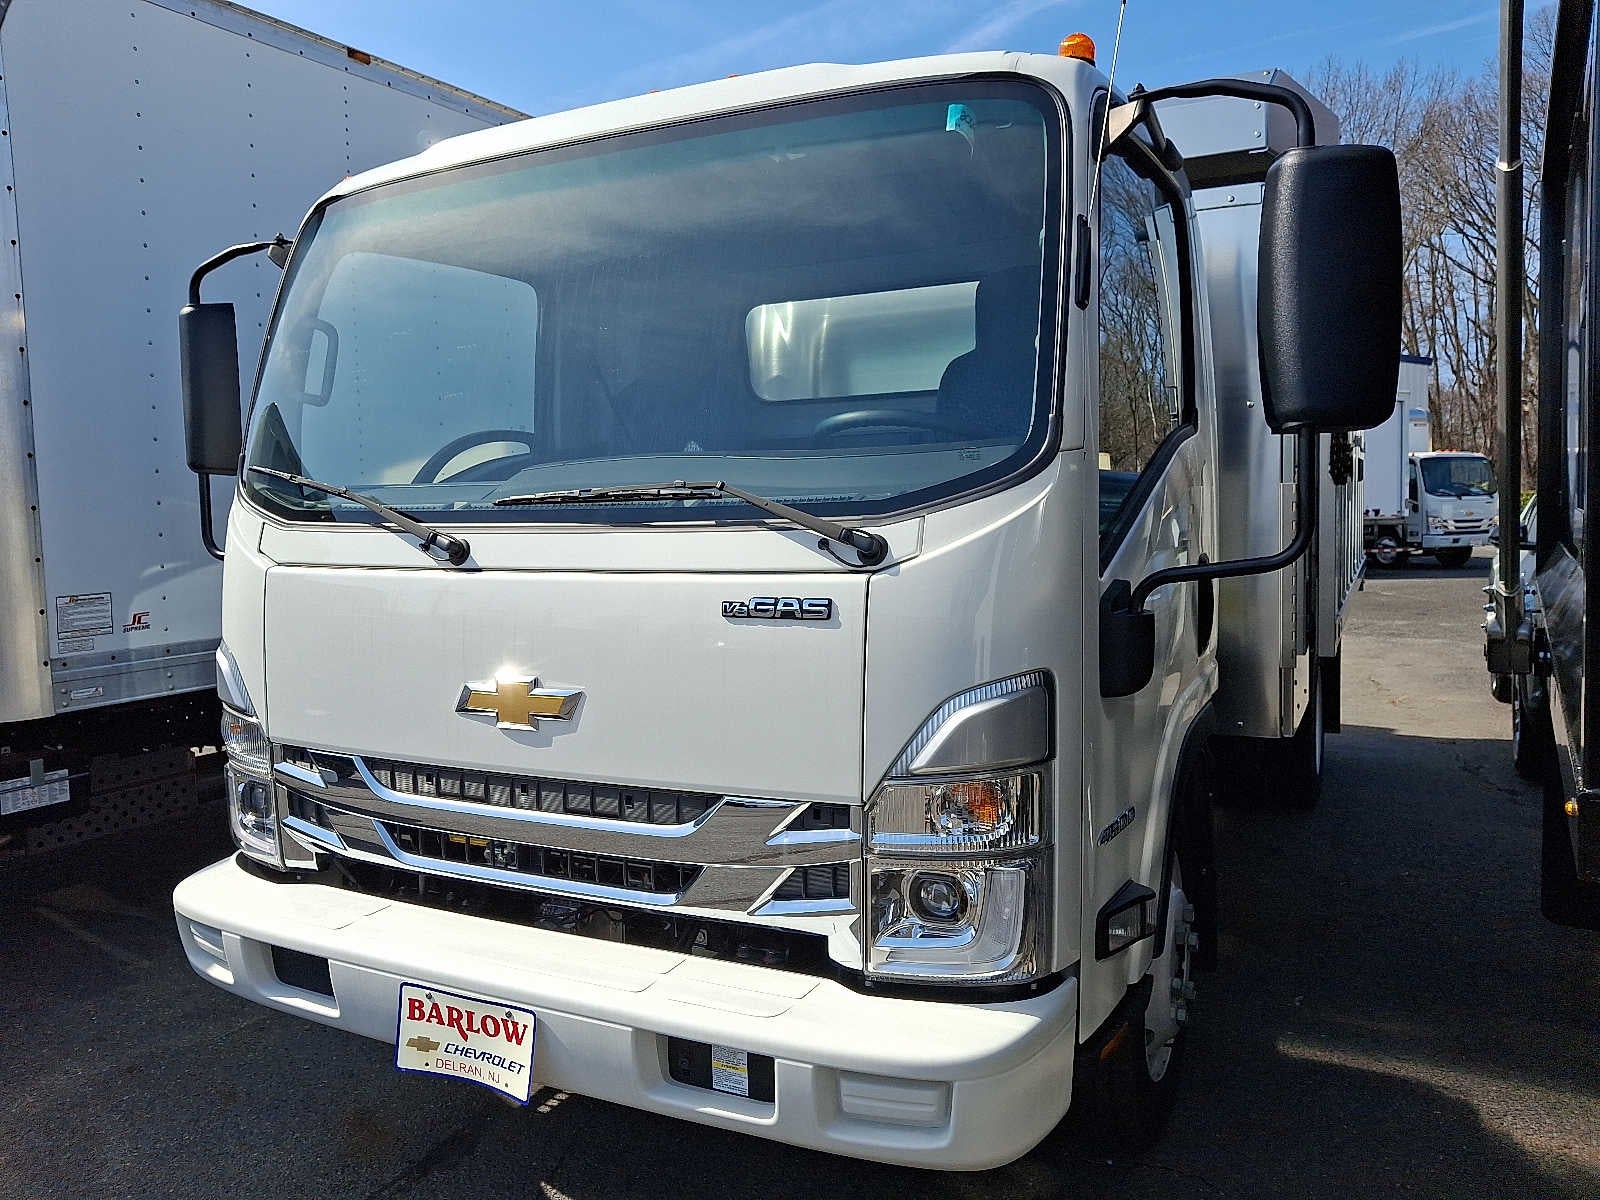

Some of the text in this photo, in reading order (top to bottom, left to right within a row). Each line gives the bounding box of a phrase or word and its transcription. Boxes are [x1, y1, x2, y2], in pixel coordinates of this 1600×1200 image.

[749, 597, 832, 620] GAS
[123, 624, 151, 634] SUPREME
[407, 998, 528, 1046] BARLOW
[436, 1058, 501, 1084] DELRAN, NJ
[444, 1043, 526, 1074] CHEVROLET
